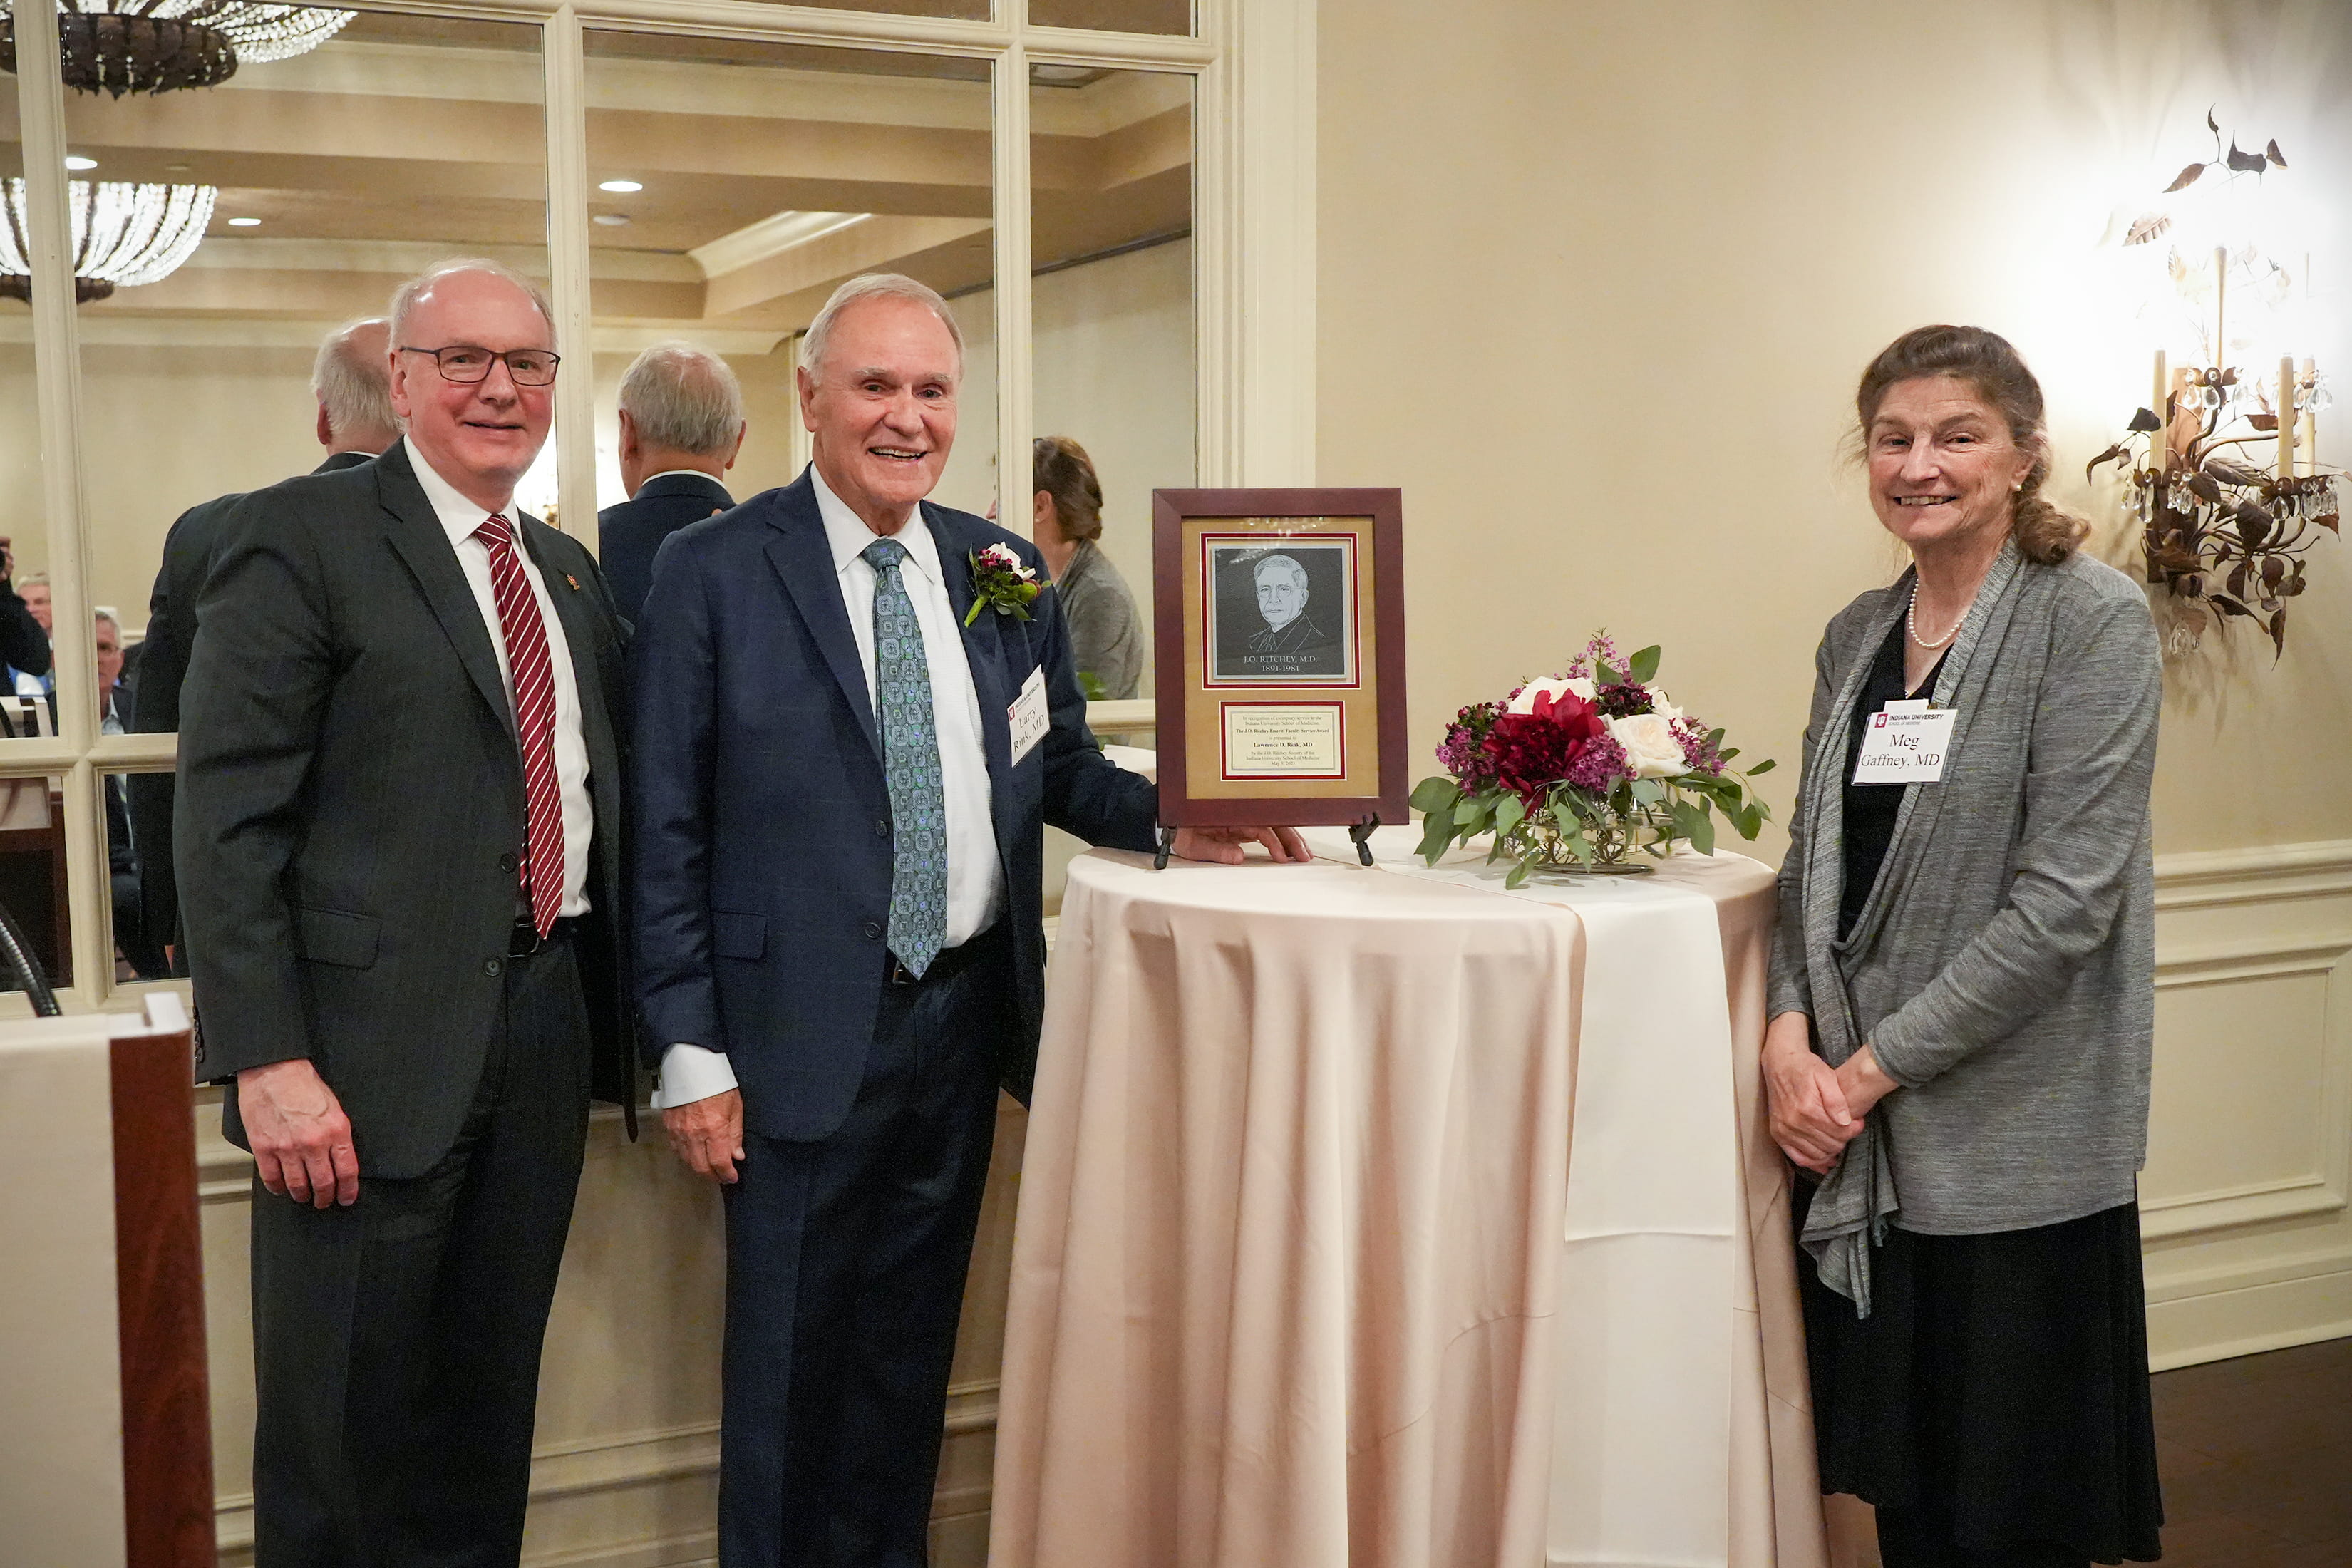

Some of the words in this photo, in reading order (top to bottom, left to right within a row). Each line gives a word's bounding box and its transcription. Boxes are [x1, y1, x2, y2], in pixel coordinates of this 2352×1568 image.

[1019, 707, 1036, 728] Larry
[1013, 731, 1031, 753] Rink,
[1032, 715, 1044, 733] MD
[1889, 734, 1919, 750] Meg
[1861, 754, 1909, 769] Gaffney,
[1916, 754, 1939, 765] MD
